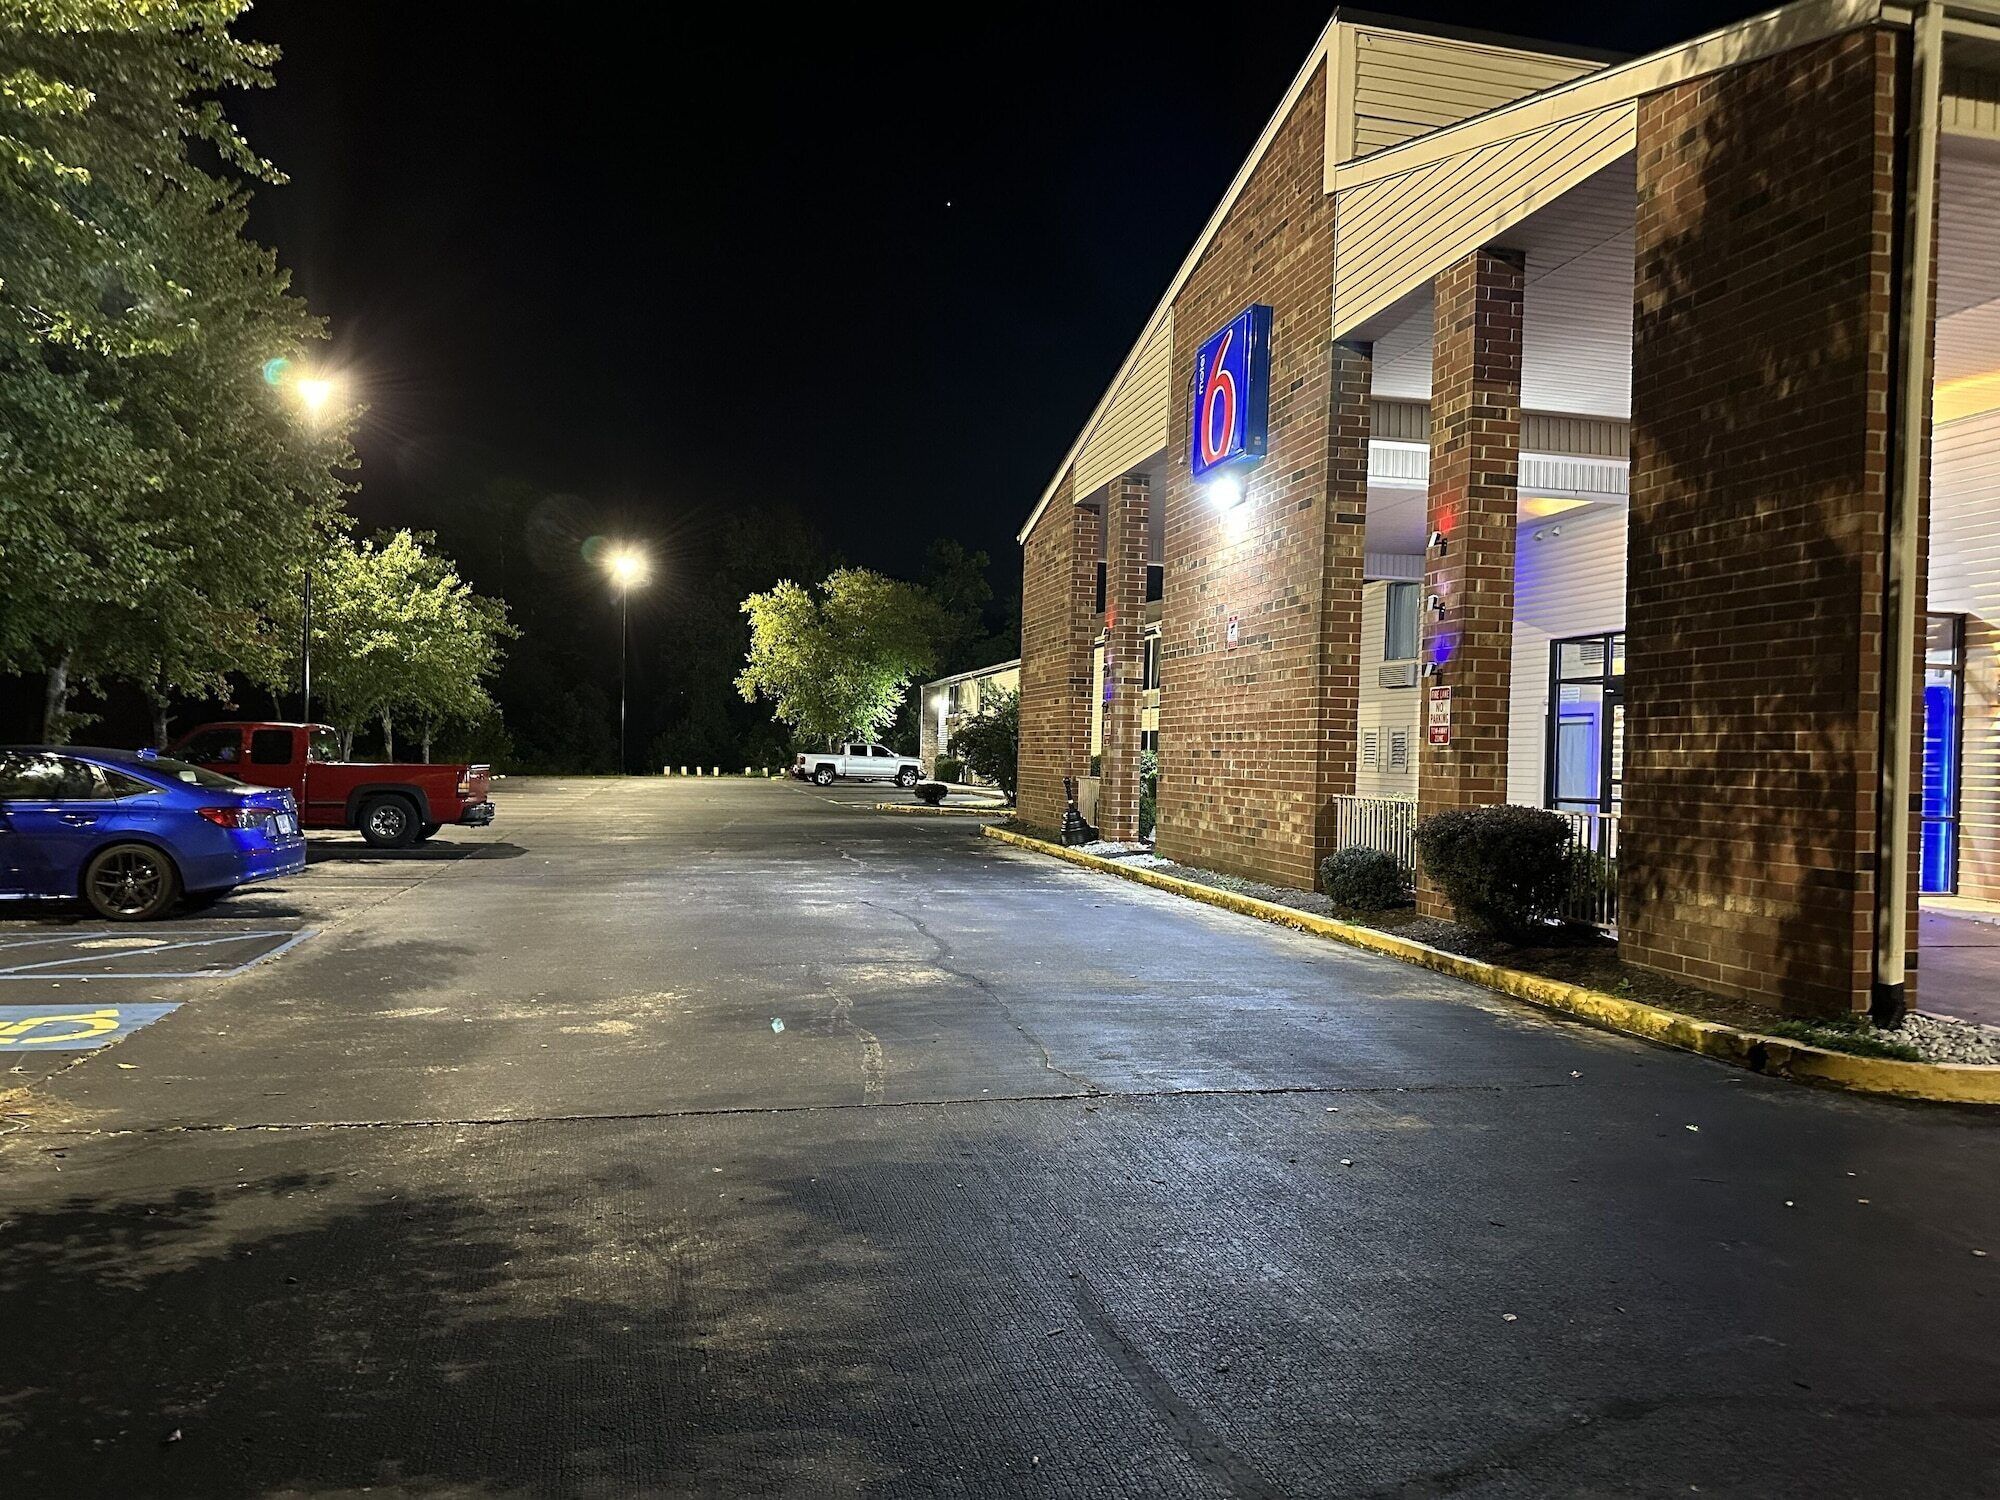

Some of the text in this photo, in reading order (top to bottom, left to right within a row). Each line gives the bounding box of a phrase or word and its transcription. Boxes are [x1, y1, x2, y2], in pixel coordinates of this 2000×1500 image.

[1201, 328, 1237, 467] 6
[1431, 689, 1449, 699] FIRE LANE
[1435, 702, 1443, 712] NO
[1431, 713, 1448, 724] PARKING
